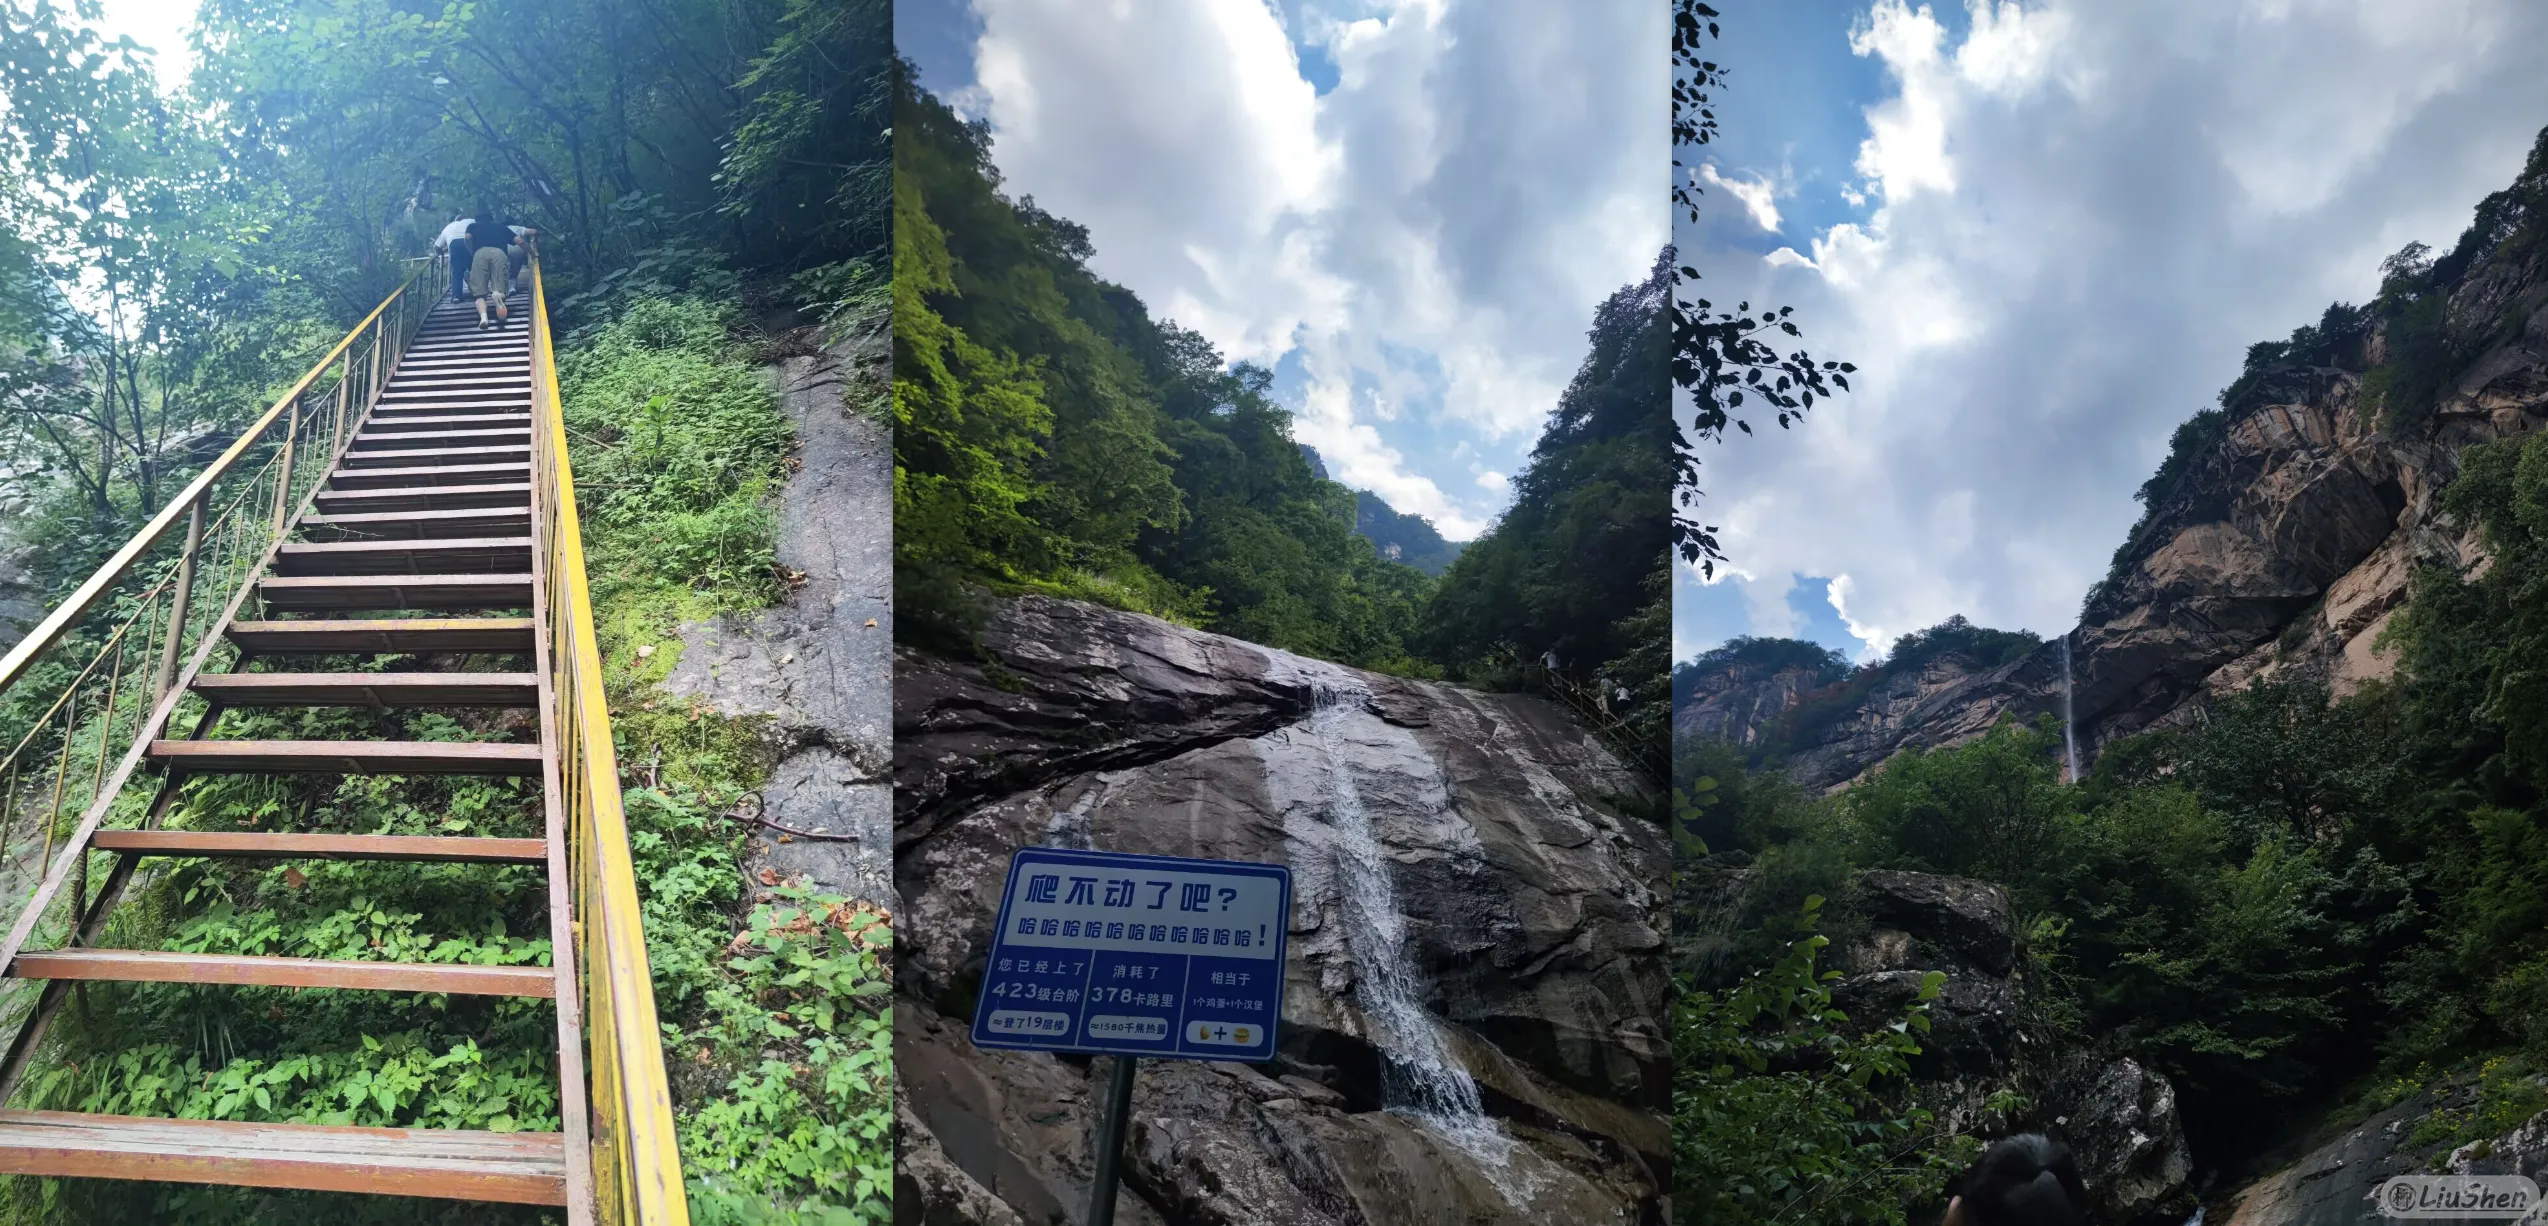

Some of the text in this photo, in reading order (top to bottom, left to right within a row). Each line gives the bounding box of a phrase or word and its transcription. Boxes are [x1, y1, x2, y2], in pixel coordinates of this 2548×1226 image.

[1025, 874, 1237, 912] 爬不动了吧?
[1018, 917, 1266, 947] 哈哈哈哈哈哈哈哈哈哈哈!
[998, 958, 1085, 975] 您已经上了
[1113, 965, 1159, 979] 消耗了
[1211, 971, 1251, 986] 相当于
[992, 982, 1080, 1003] 423级台阶
[1091, 988, 1174, 1007] 378卡路里
